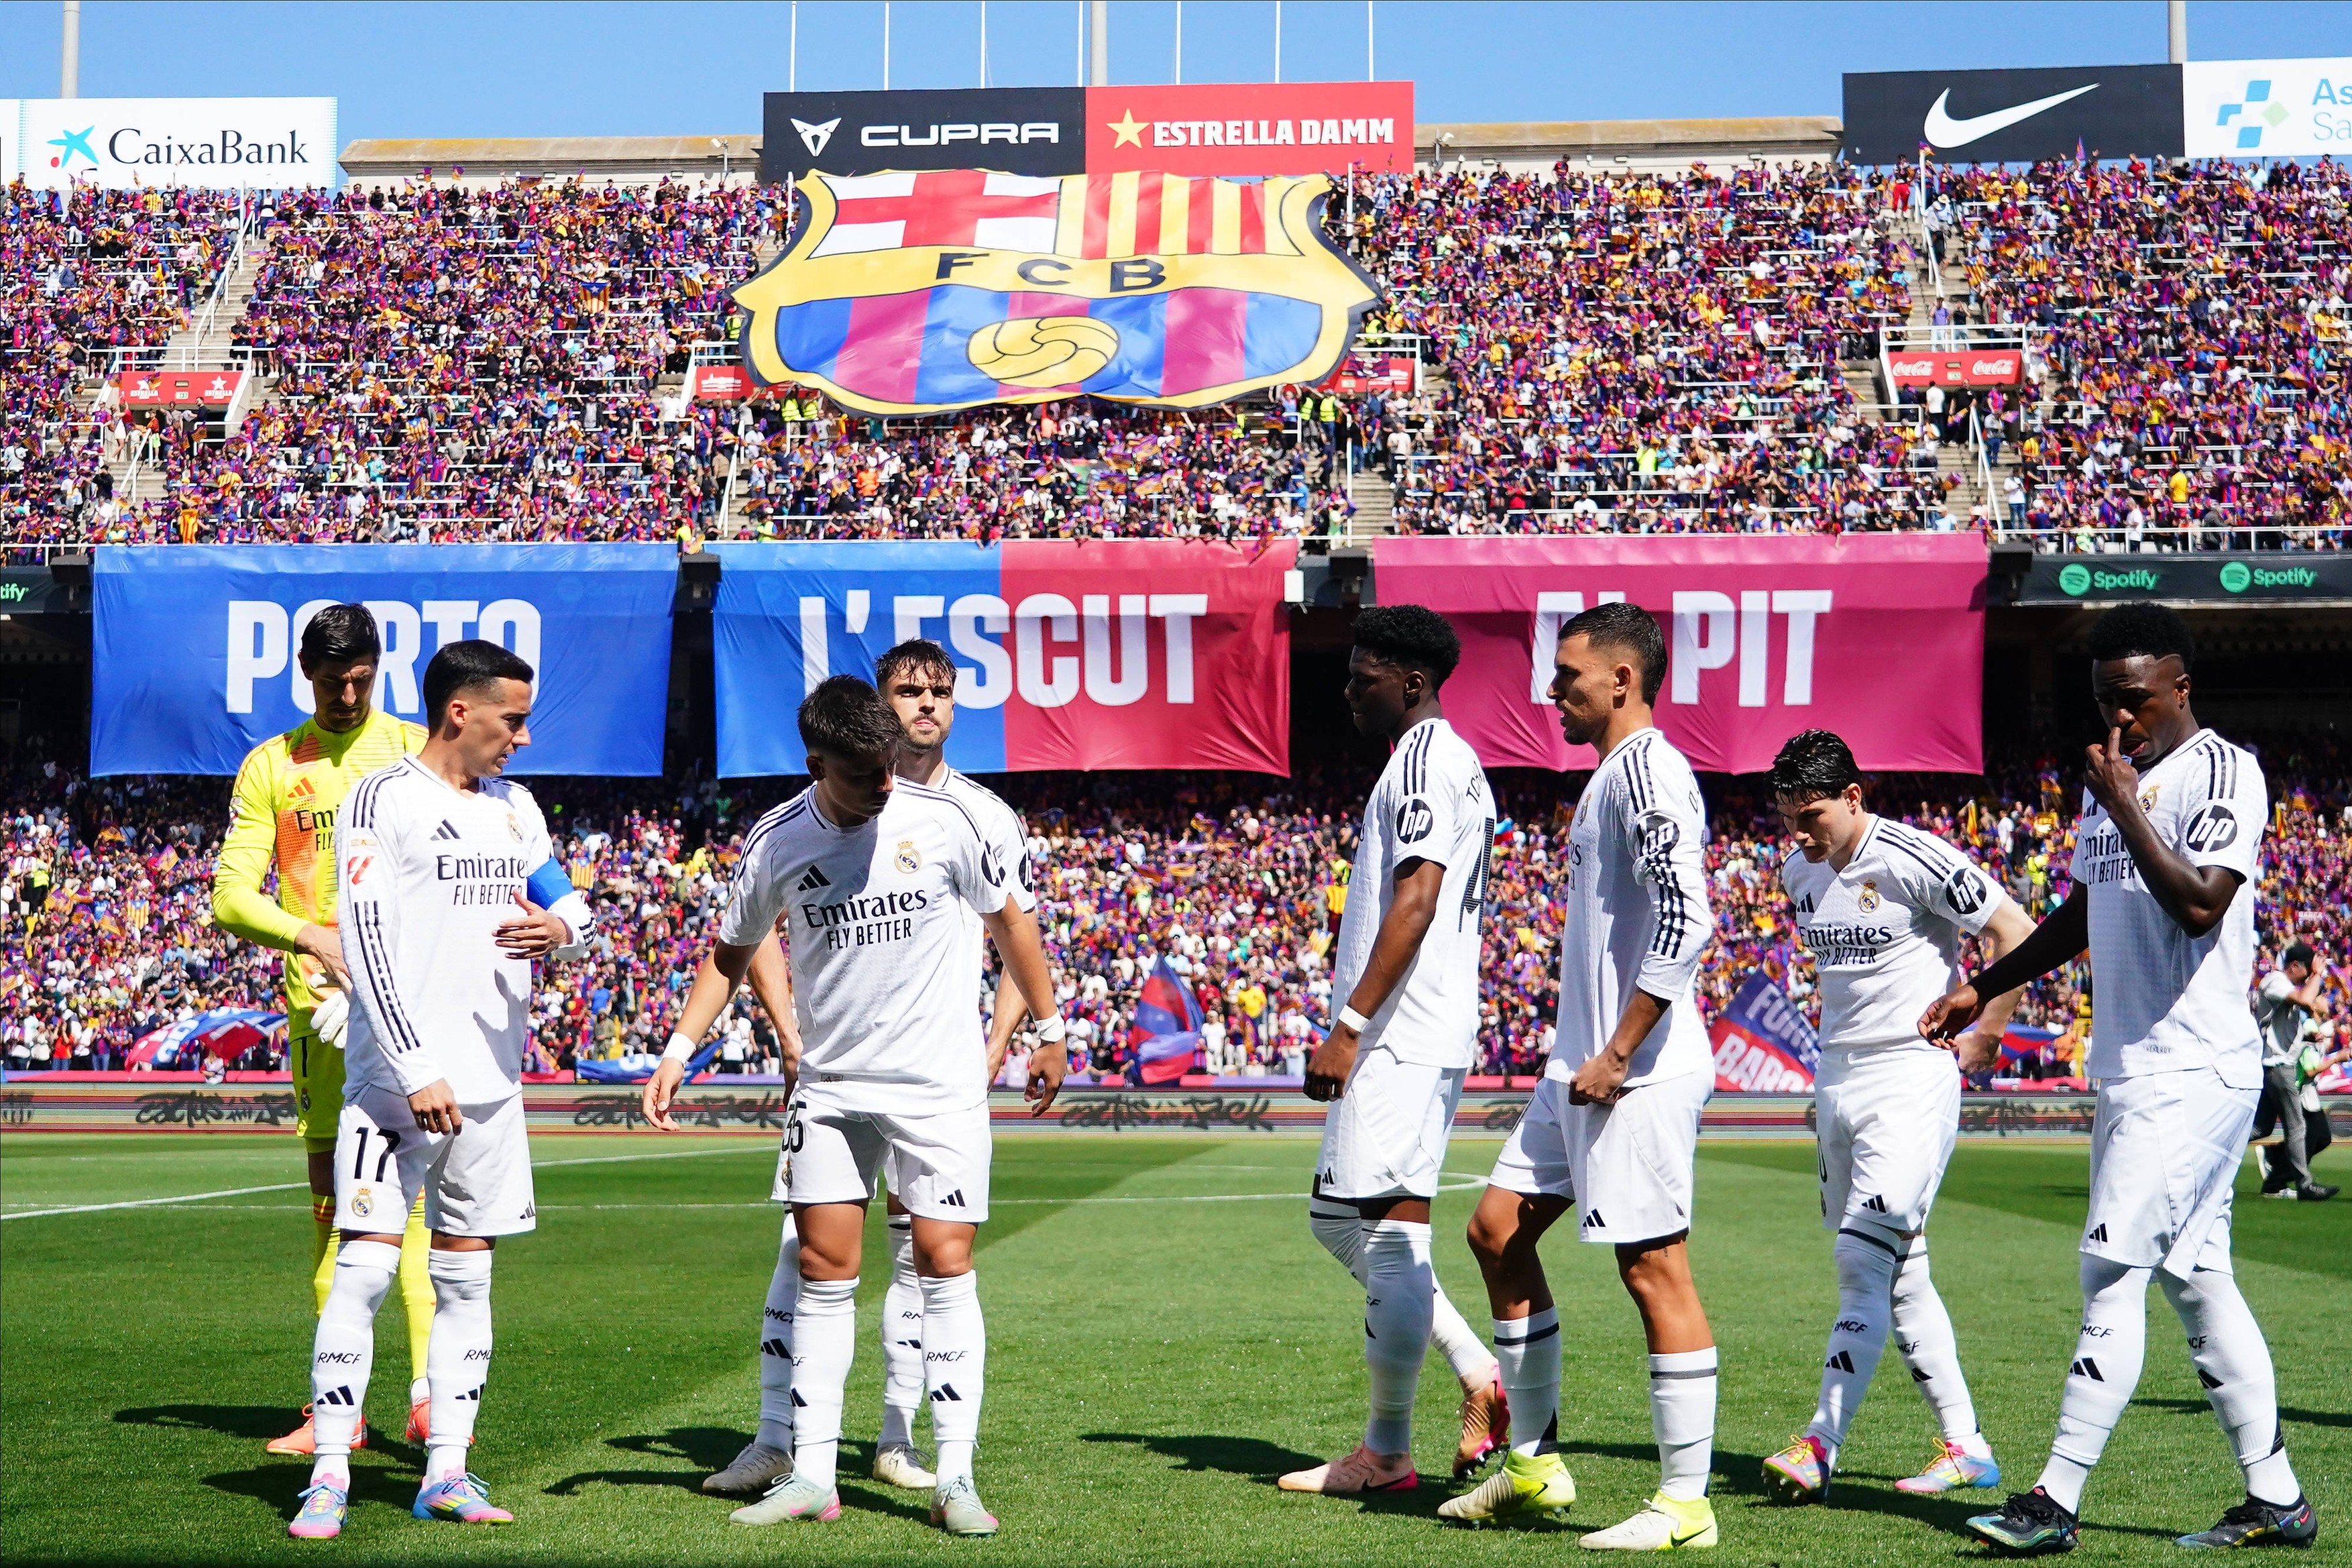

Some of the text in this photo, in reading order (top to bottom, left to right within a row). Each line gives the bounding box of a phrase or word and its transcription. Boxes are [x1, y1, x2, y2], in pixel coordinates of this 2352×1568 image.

[860, 122, 1060, 147] CUPRA
[1153, 117, 1394, 147] ESTRELLA DAMM
[109, 128, 309, 164] CaixaBank
[204, 389, 233, 397] ESTRELLA
[2093, 569, 2158, 591] Spotify
[2253, 566, 2316, 588] Spotify
[1671, 590, 1833, 706] PIT
[1399, 798, 1431, 845] hp
[2188, 805, 2235, 852] hp
[437, 852, 529, 880] Emirate
[2098, 857, 2135, 883] BETTER
[454, 884, 475, 905] FLY
[801, 889, 927, 929] Emirates
[826, 917, 911, 950] FLY BETTER
[1832, 946, 1877, 965] BETTER
[353, 1127, 401, 1182] 17
[317, 1351, 362, 1365] RMCF
[926, 1350, 968, 1362] RMCF
